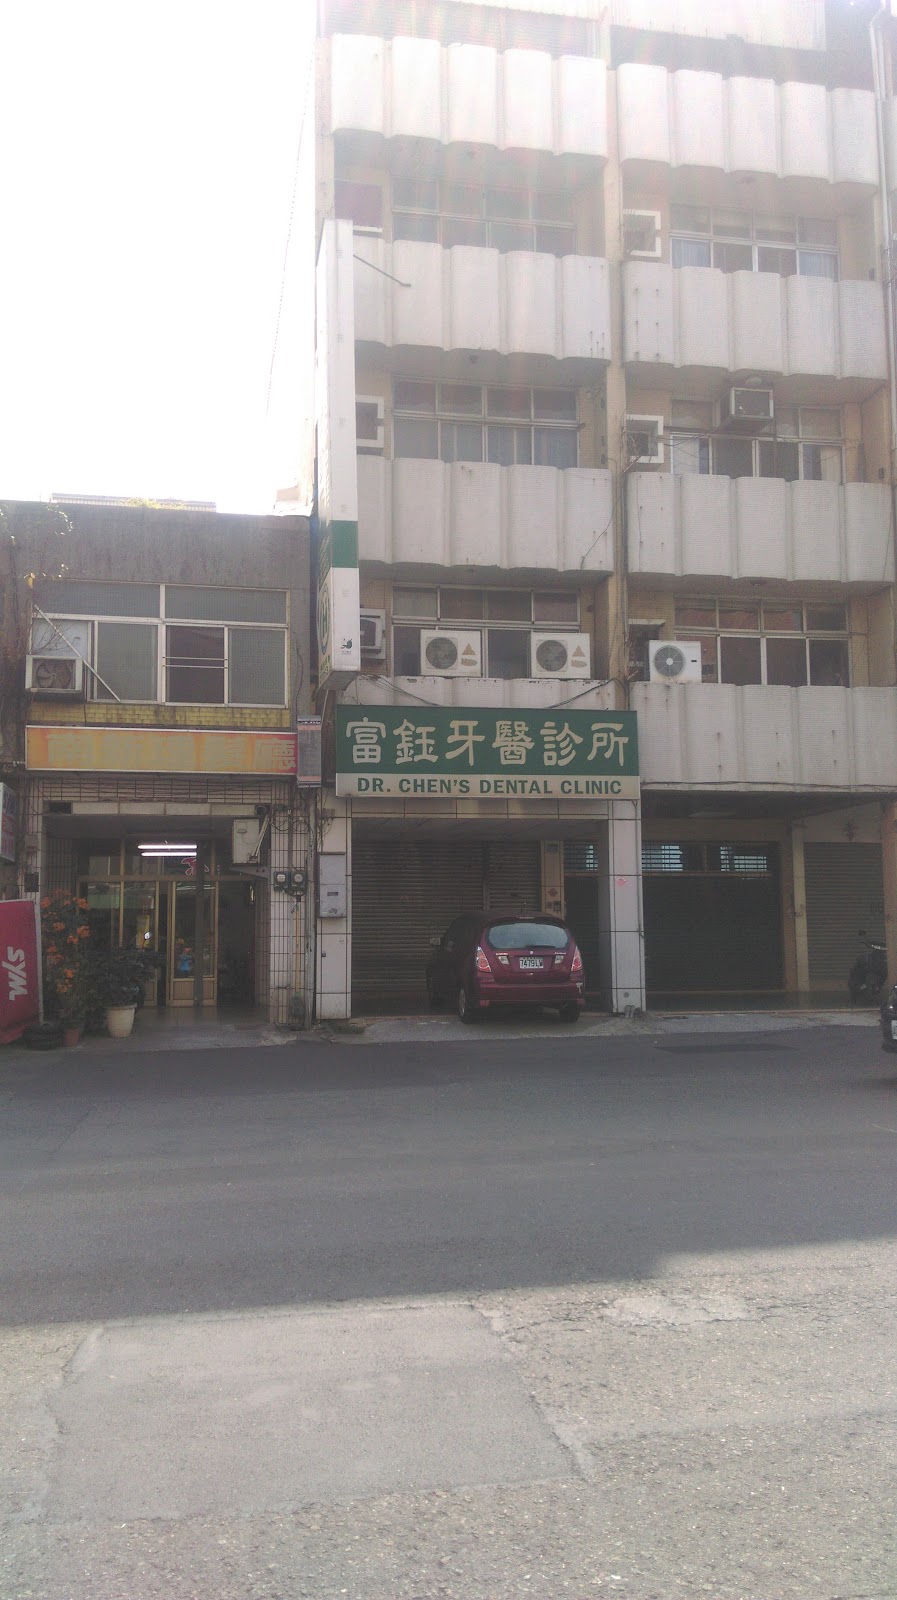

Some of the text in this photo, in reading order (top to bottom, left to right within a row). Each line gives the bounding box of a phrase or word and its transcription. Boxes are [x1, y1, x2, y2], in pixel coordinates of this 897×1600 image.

[346, 716, 629, 767] 富鈺牙醫診所
[357, 777, 622, 795] DR. CHEN'S DENTAL CLINIC
[1, 946, 28, 1001] SYM
